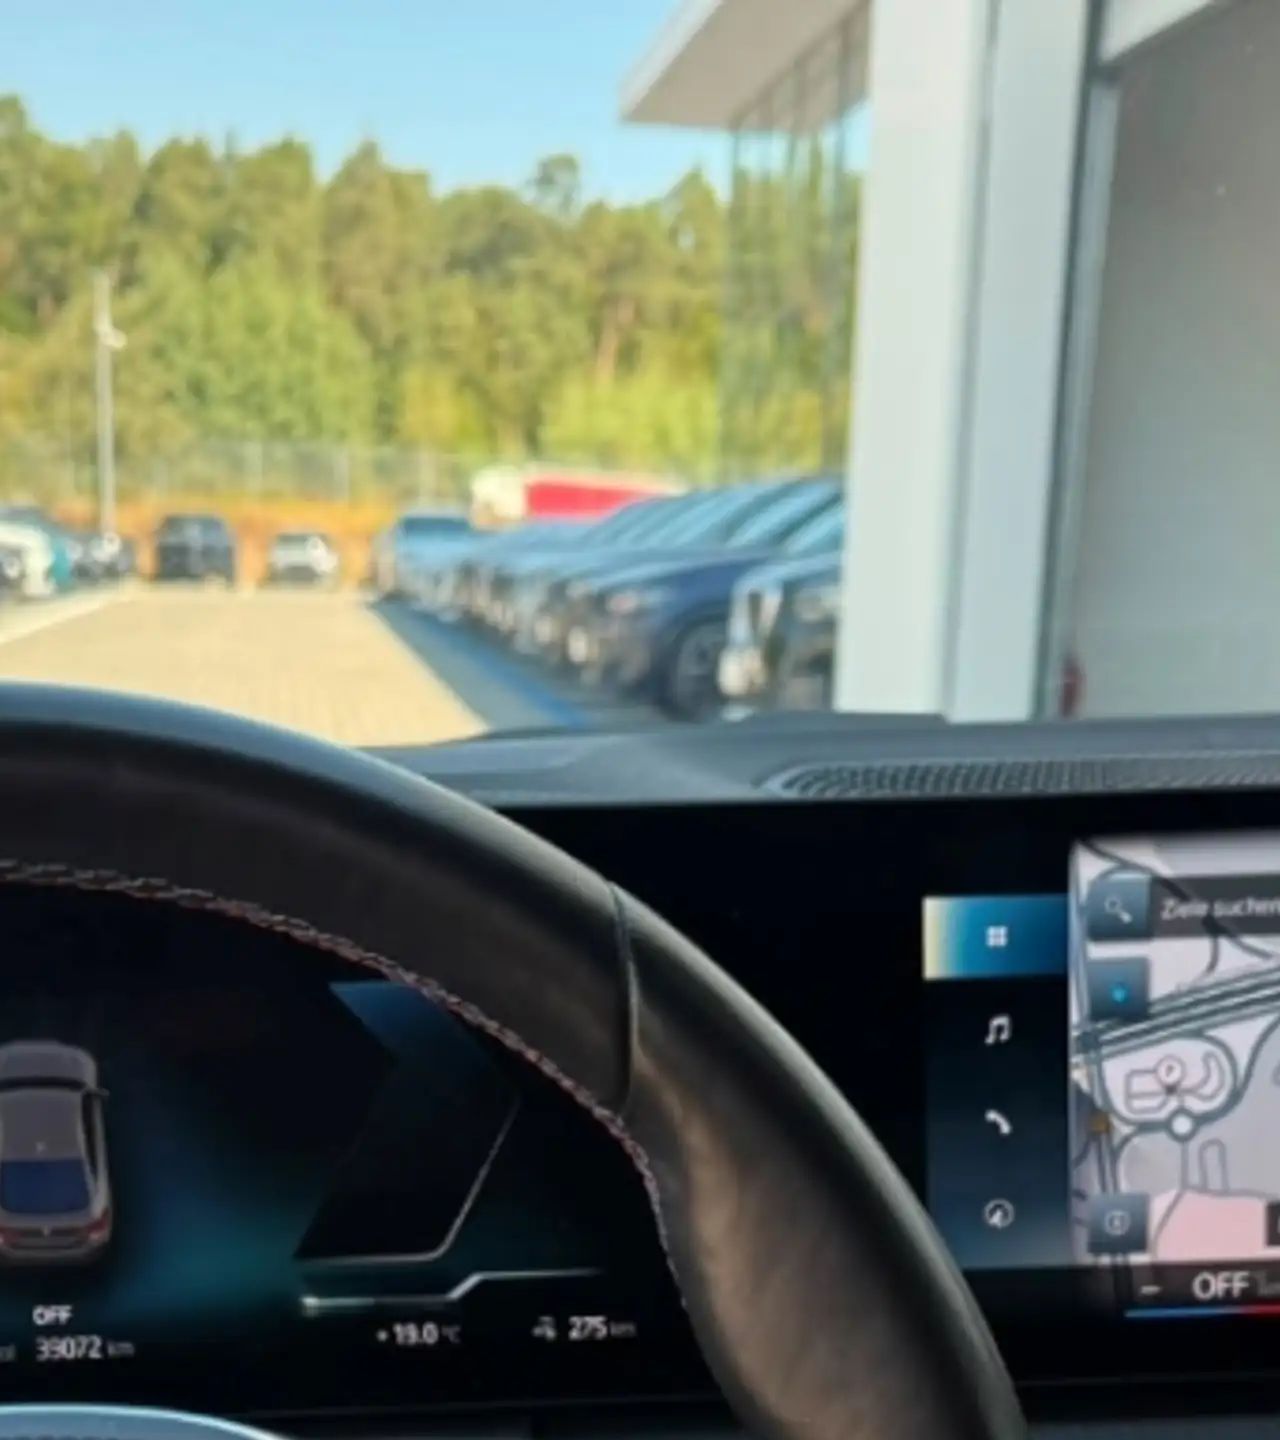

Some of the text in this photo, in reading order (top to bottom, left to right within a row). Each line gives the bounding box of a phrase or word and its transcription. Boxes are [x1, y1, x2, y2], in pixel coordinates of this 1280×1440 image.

[1192, 1270, 1250, 1301] OFF
[32, 1304, 72, 1326] OFF
[568, 1315, 608, 1341] 275
[36, 1335, 103, 1361] 39072
